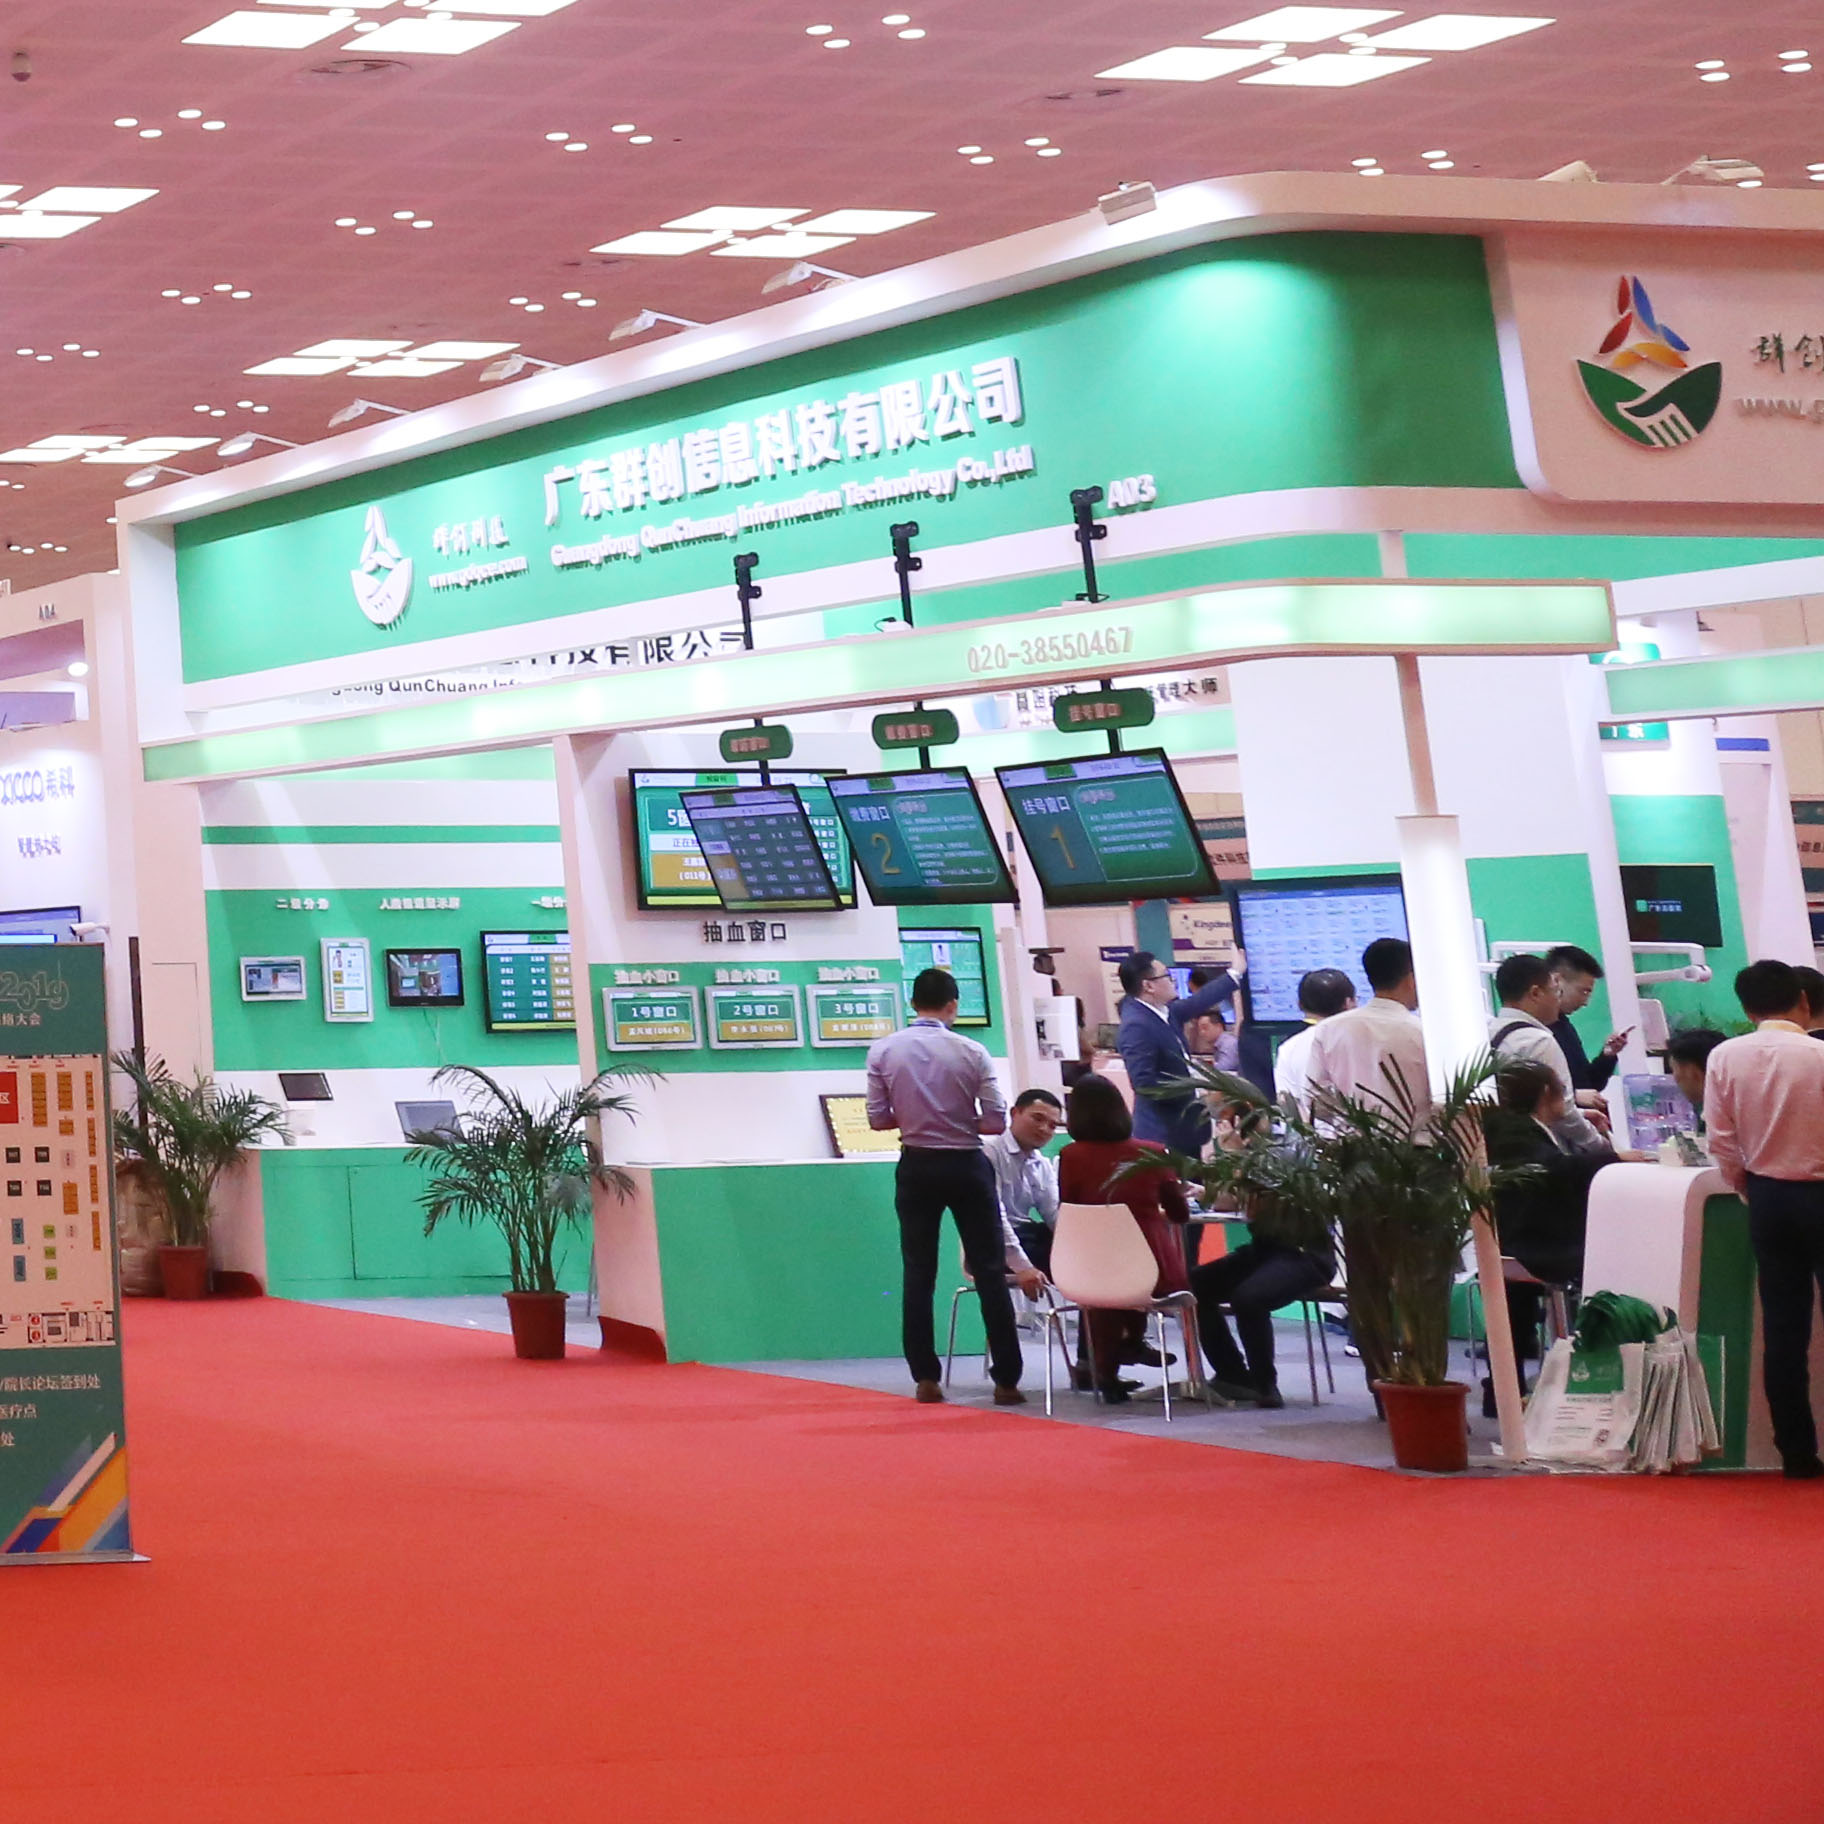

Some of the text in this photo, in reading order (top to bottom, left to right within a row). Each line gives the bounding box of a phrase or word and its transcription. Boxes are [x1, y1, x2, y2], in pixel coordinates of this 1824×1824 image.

[544, 356, 1023, 527] 广东群创信息科技有限公司
[1107, 475, 1156, 509] A03
[551, 532, 641, 568] Guangdong
[736, 489, 844, 528] Information
[843, 467, 958, 511] Technology
[966, 626, 1135, 673] 020-38550467
[1023, 795, 1071, 816] 挂号窗口
[871, 832, 901, 874] 2
[1051, 826, 1077, 870] 1
[703, 920, 788, 943] 抽血窗口
[0, 960, 70, 1012] 2019
[631, 1004, 678, 1018] 1号窗口
[732, 1004, 780, 1017] 2号窗口
[834, 1002, 880, 1015] 3号窗口
